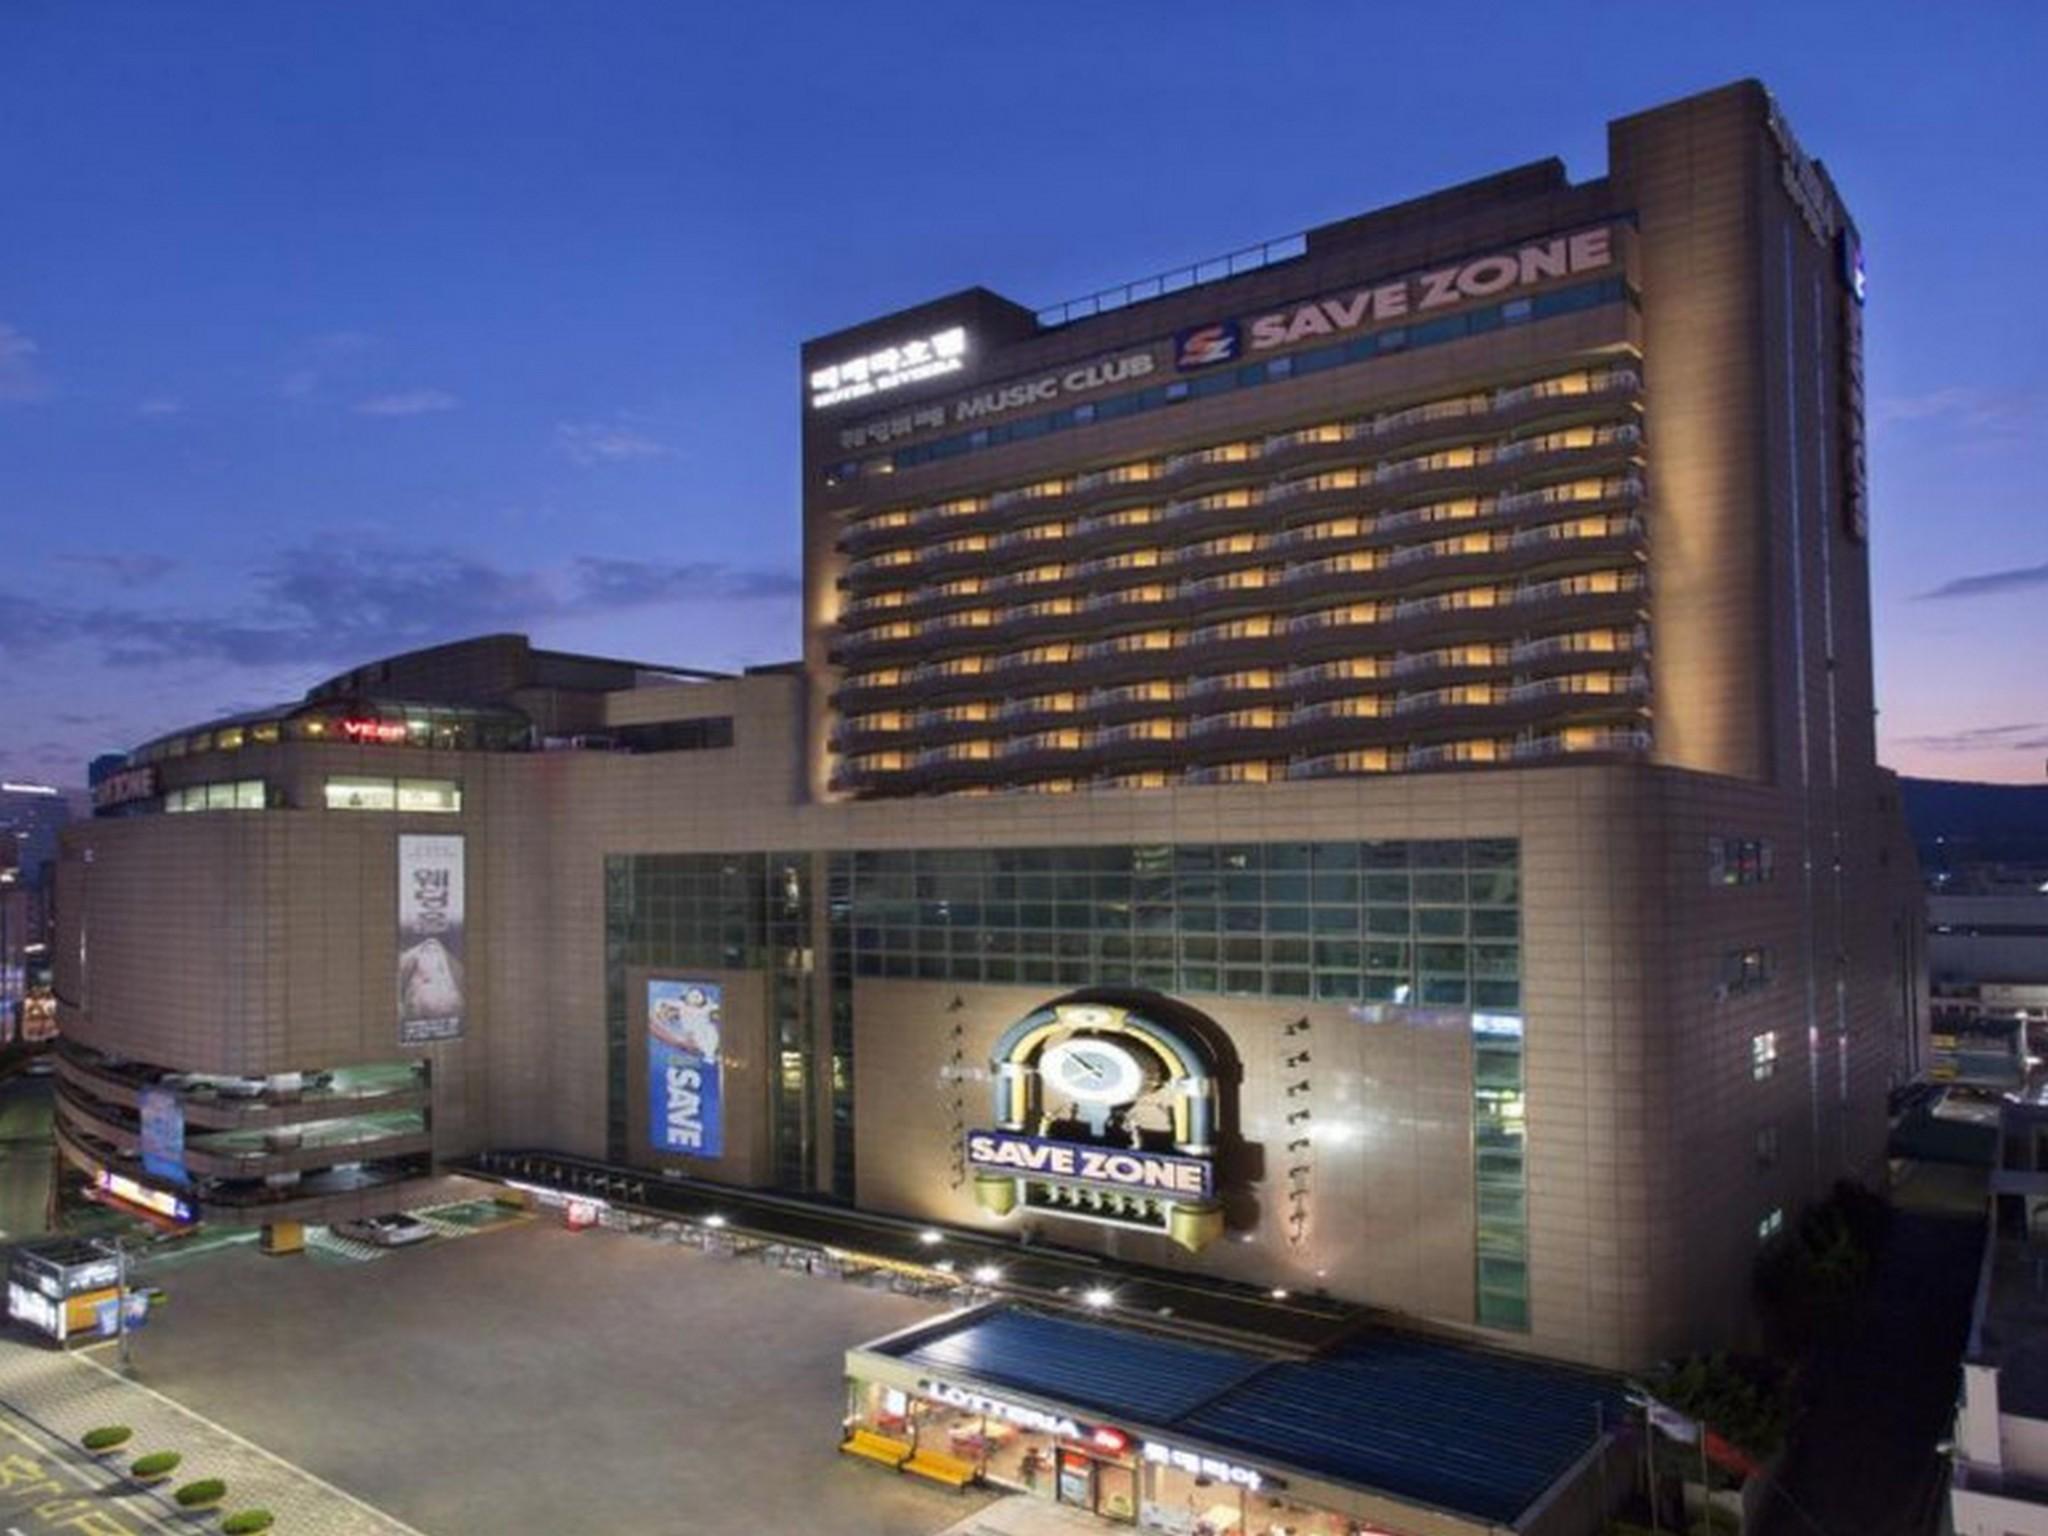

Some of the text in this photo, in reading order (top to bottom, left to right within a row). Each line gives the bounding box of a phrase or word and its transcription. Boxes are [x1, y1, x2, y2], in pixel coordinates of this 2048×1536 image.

[1250, 283, 1409, 350] SAVE
[1418, 228, 1612, 309] ZONE
[957, 353, 1155, 420] MUSIC CLUB
[666, 1066, 704, 1149] SAVE
[970, 1137, 1202, 1192] SAVE ZONE
[928, 1382, 1083, 1438] LOTTERIA
